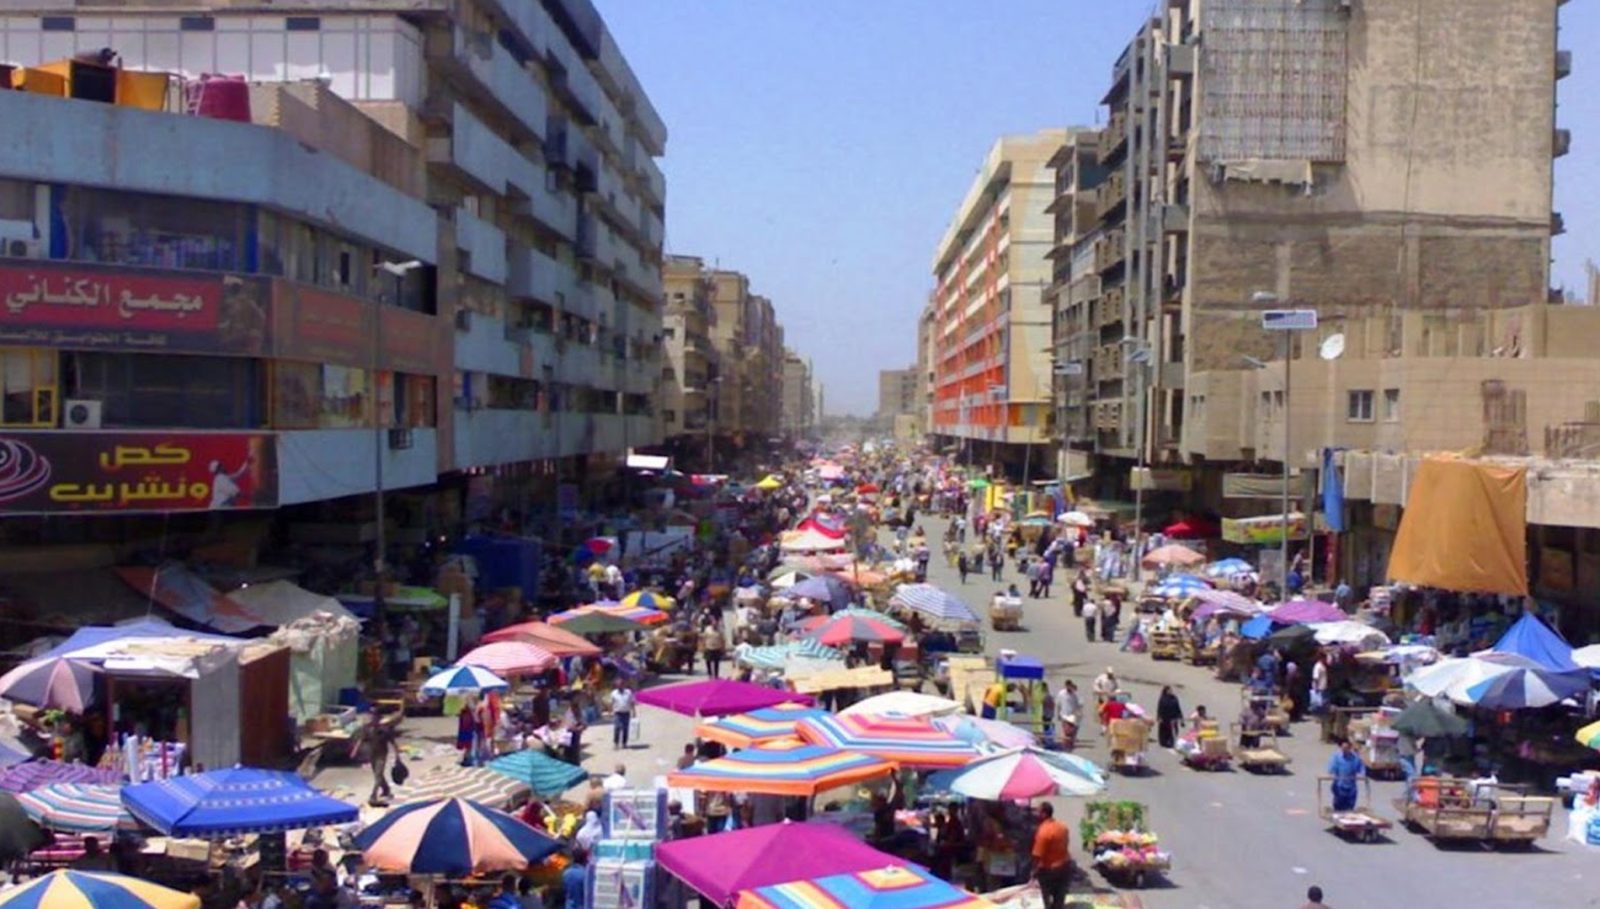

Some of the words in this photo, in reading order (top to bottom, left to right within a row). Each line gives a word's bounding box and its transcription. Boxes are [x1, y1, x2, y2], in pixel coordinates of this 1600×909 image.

[6, 274, 111, 313] الكناني
[119, 288, 204, 318] مجمع
[98, 443, 191, 471] كص
